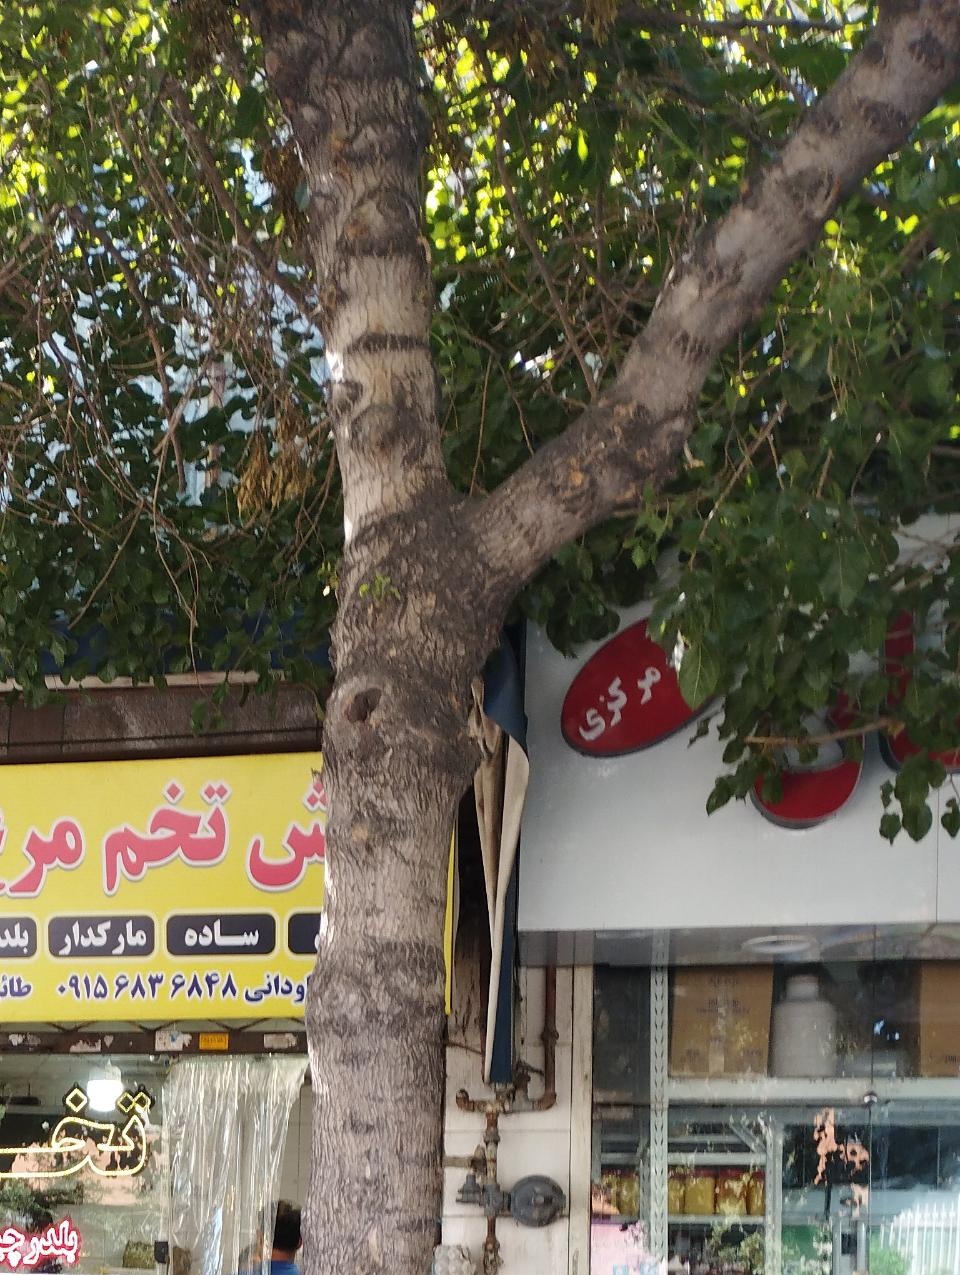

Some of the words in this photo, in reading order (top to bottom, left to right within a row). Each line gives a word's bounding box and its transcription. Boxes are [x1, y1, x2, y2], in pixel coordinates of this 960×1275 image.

[579, 667, 661, 741] مرکزی
[105, 782, 229, 892] تخم
[58, 919, 147, 956] مارکدار
[184, 920, 259, 948] ساده
[245, 974, 311, 1003] ودانی
